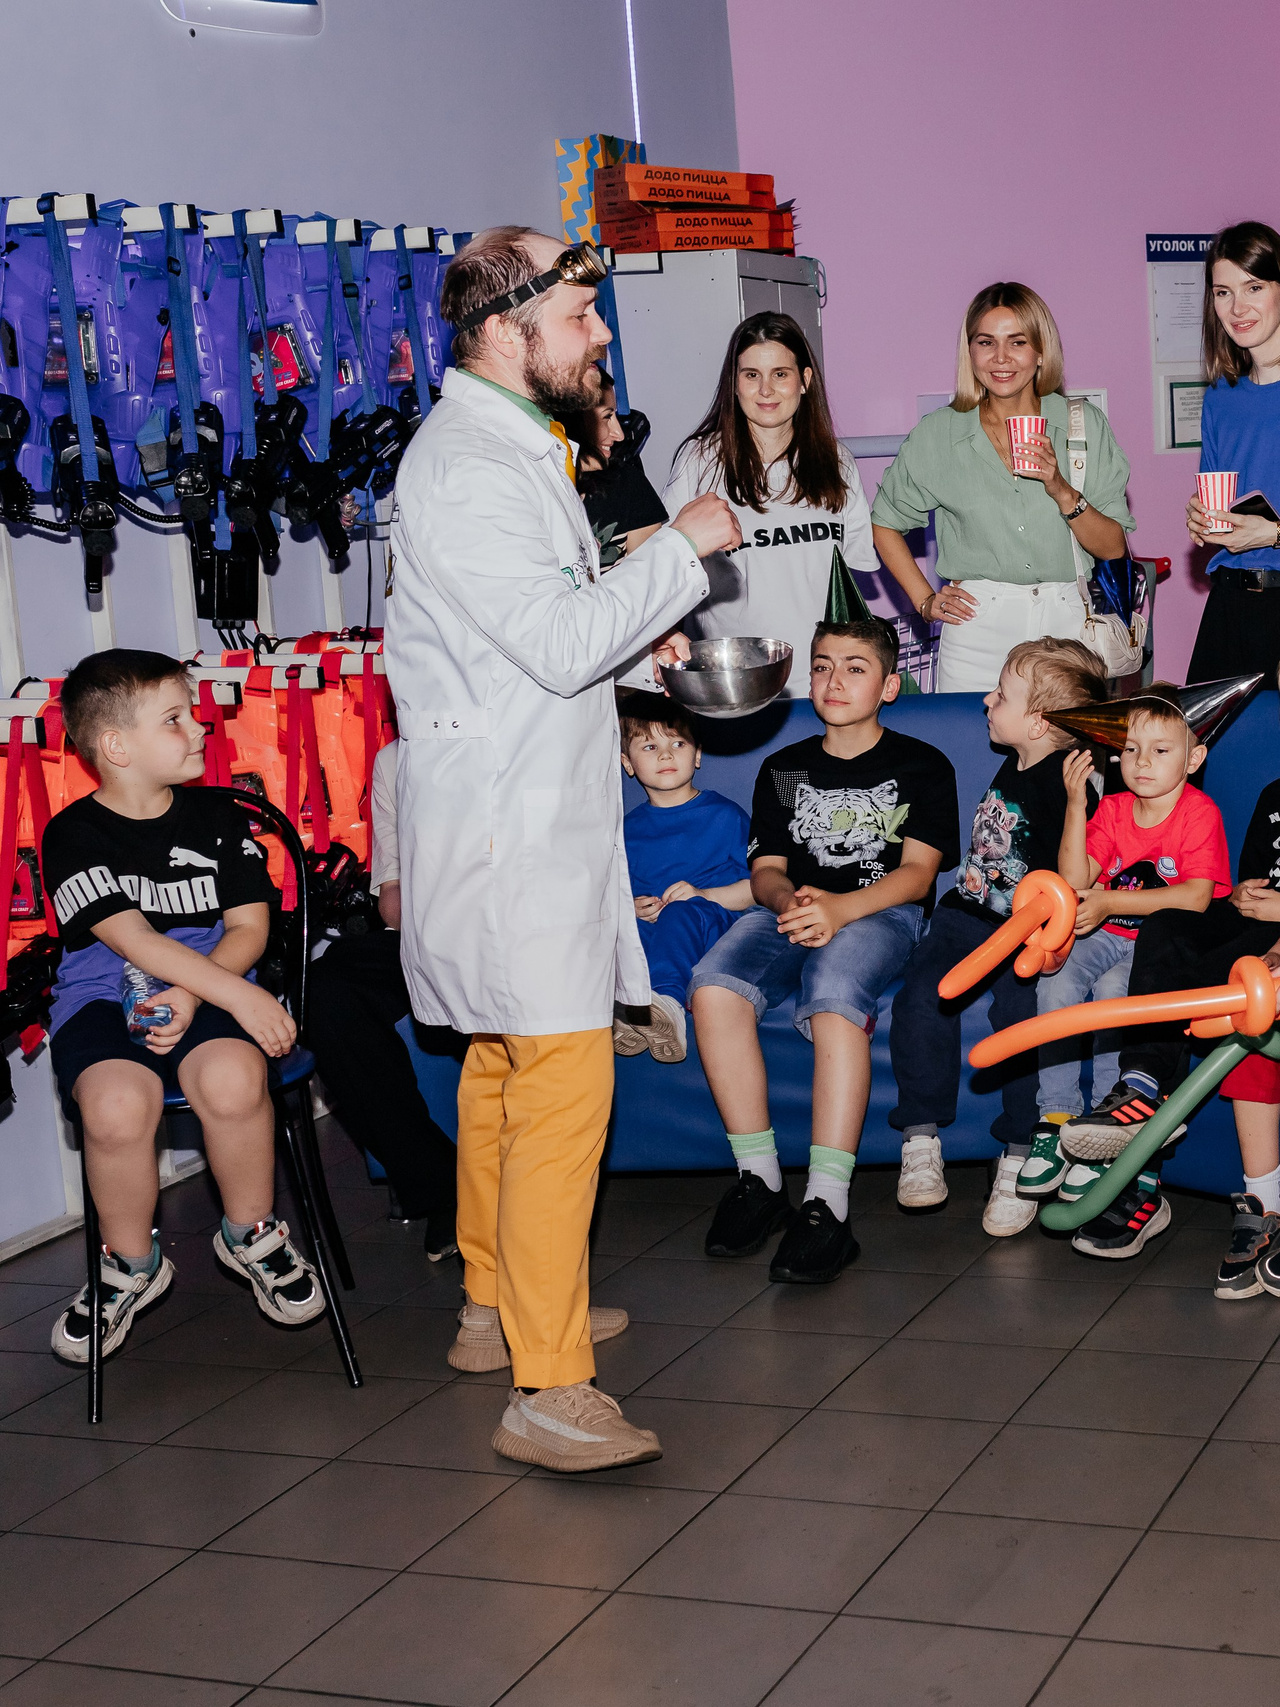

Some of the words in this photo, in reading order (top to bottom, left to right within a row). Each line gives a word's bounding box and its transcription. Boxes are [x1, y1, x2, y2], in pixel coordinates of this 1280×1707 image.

[644, 169, 680, 182] ДОДО
[683, 172, 728, 186] ПИЦЦА
[648, 187, 684, 199] ДОДО
[686, 189, 731, 202] ПИЦЦА
[675, 217, 709, 228] ДОДО
[711, 217, 753, 227] ПИЦЦА
[675, 236, 709, 247] ДОДО
[711, 235, 754, 246] ПИЦЦА
[1149, 240, 1195, 252] УГОЛОК
[860, 860, 885, 871] LOSE
[871, 871, 888, 880] CO
[53, 865, 122, 925] UMA
